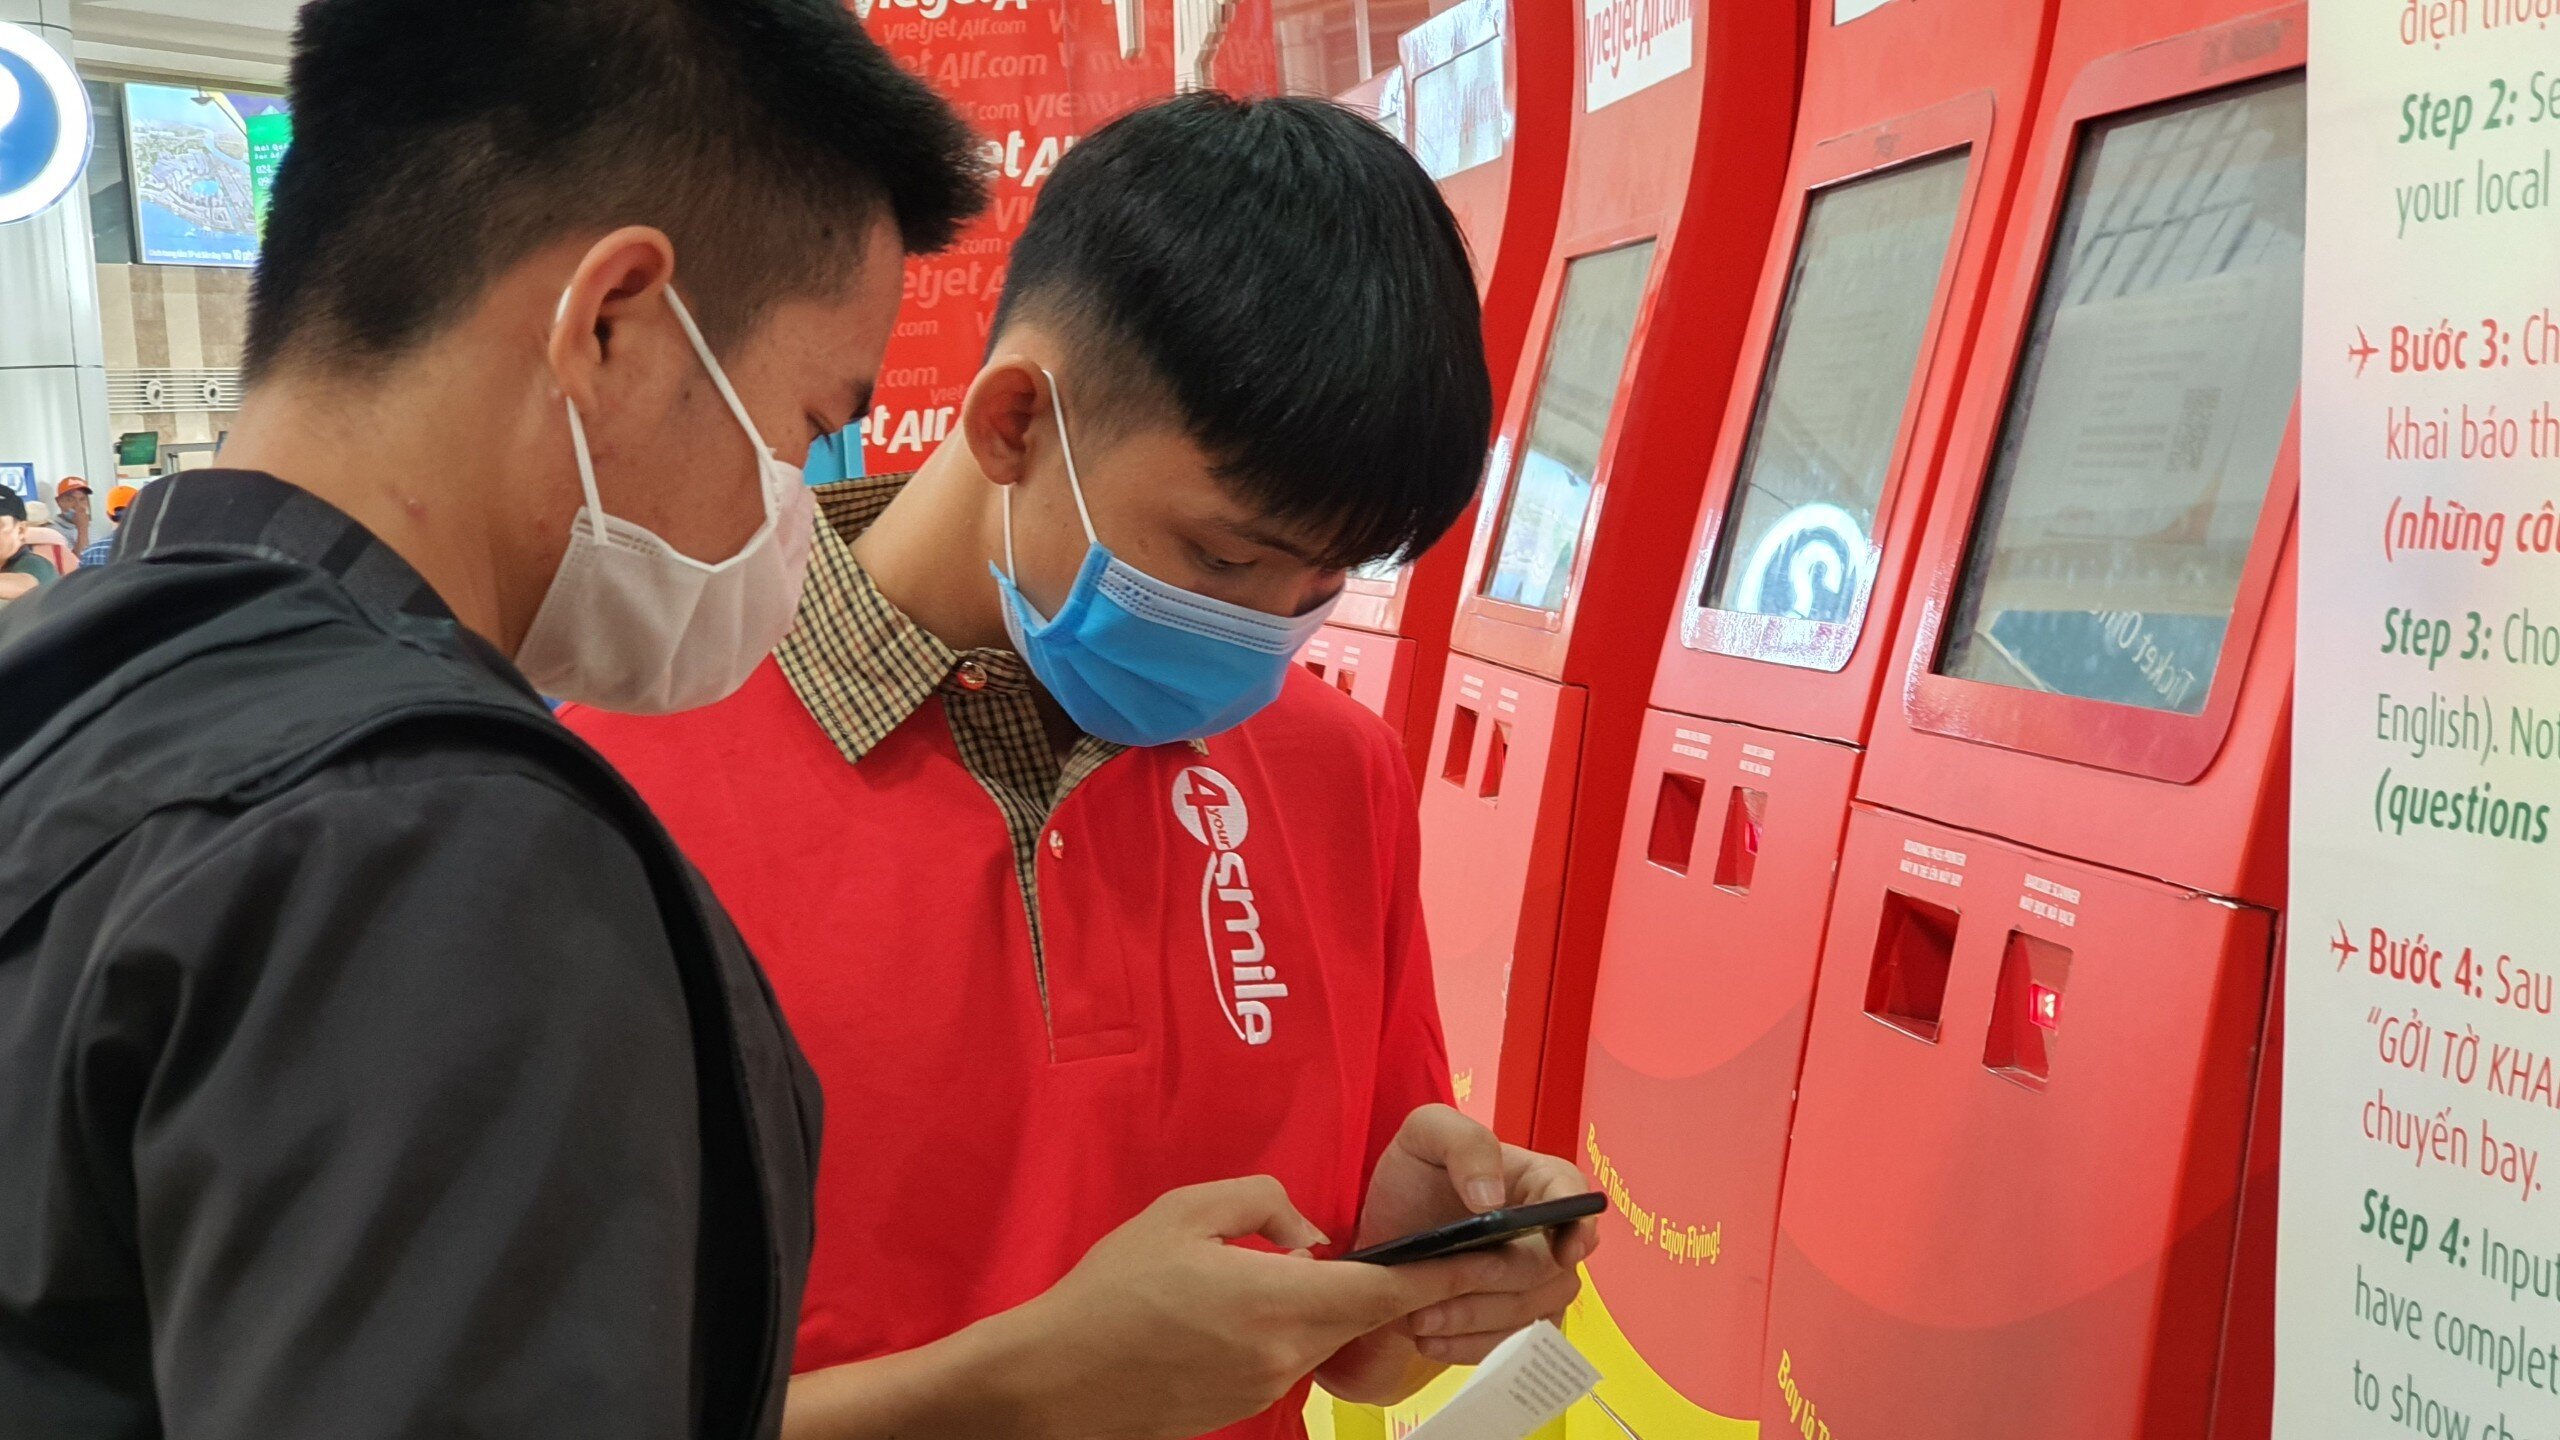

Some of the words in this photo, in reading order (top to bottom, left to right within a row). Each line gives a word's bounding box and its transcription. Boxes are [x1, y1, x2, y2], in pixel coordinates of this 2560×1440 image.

[2398, 92, 2473, 150] Step
[2482, 78, 2518, 131] 2:
[2396, 178, 2465, 239] your
[2476, 148, 2550, 215] local
[2390, 318, 2468, 373] Bước
[2479, 317, 2509, 369] 3:
[2386, 406, 2449, 461] khai
[2461, 403, 2518, 459] báo
[2516, 499, 2560, 553] câ
[2380, 607, 2451, 671] Step
[2460, 611, 2493, 661] 3:
[2503, 607, 2560, 666] Cho
[2377, 691, 2498, 766] English).
[2510, 706, 2560, 759] No
[1206, 807, 1231, 849] your
[2375, 767, 2550, 843] (questions
[1214, 851, 1289, 1046] smile
[2370, 926, 2443, 989] Bước
[2454, 946, 2483, 999] 4:
[2495, 954, 2552, 1014] Sau
[2443, 1022, 2480, 1084] TỜ
[2363, 1088, 2468, 1168] chuyến
[2481, 1118, 2542, 1202] bay.
[1660, 1217, 1686, 1265] Enjoy
[2360, 1188, 2428, 1263] Step
[2439, 1217, 2470, 1268] 4:
[2355, 1264, 2423, 1340] have
[2434, 1311, 2560, 1395] complet
[1777, 1348, 1803, 1424] Bay
[2353, 1359, 2380, 1412] to
[2390, 1373, 2470, 1440] show
